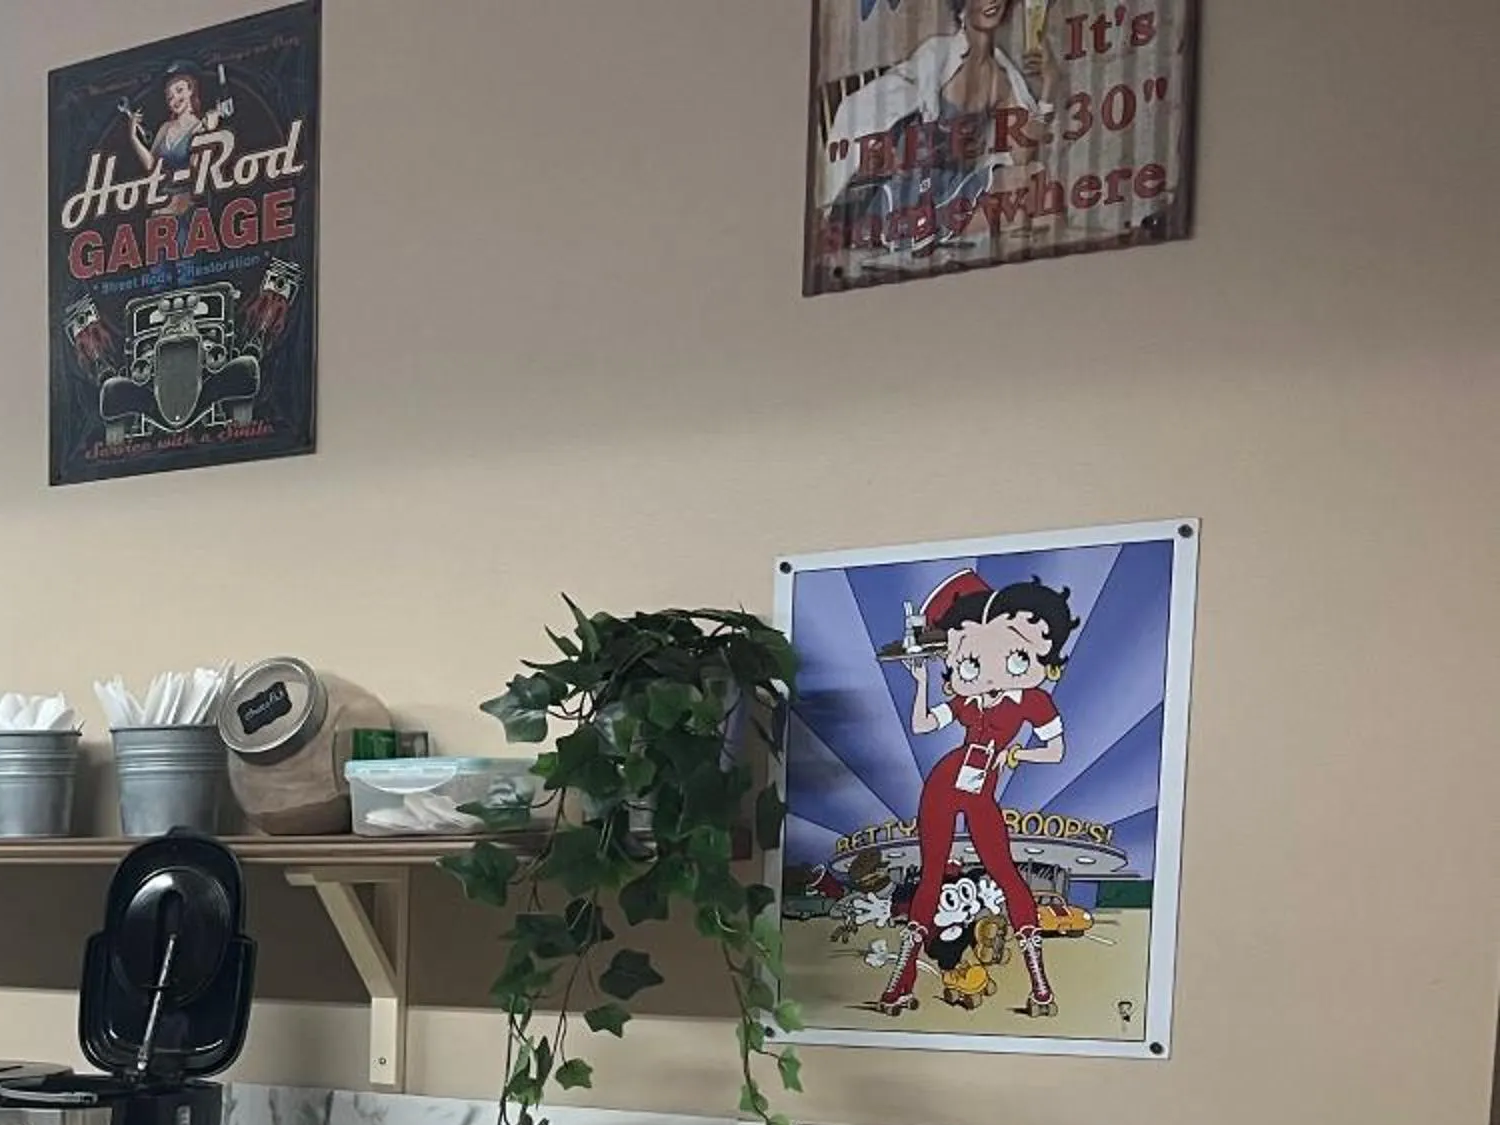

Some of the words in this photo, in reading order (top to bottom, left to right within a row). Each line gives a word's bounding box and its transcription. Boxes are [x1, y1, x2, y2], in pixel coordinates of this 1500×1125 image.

[1063, 5, 1156, 61] It's
[61, 120, 306, 229] Hot-Rod
[68, 187, 296, 280] GARAGE
[835, 817, 918, 854] BETTY
